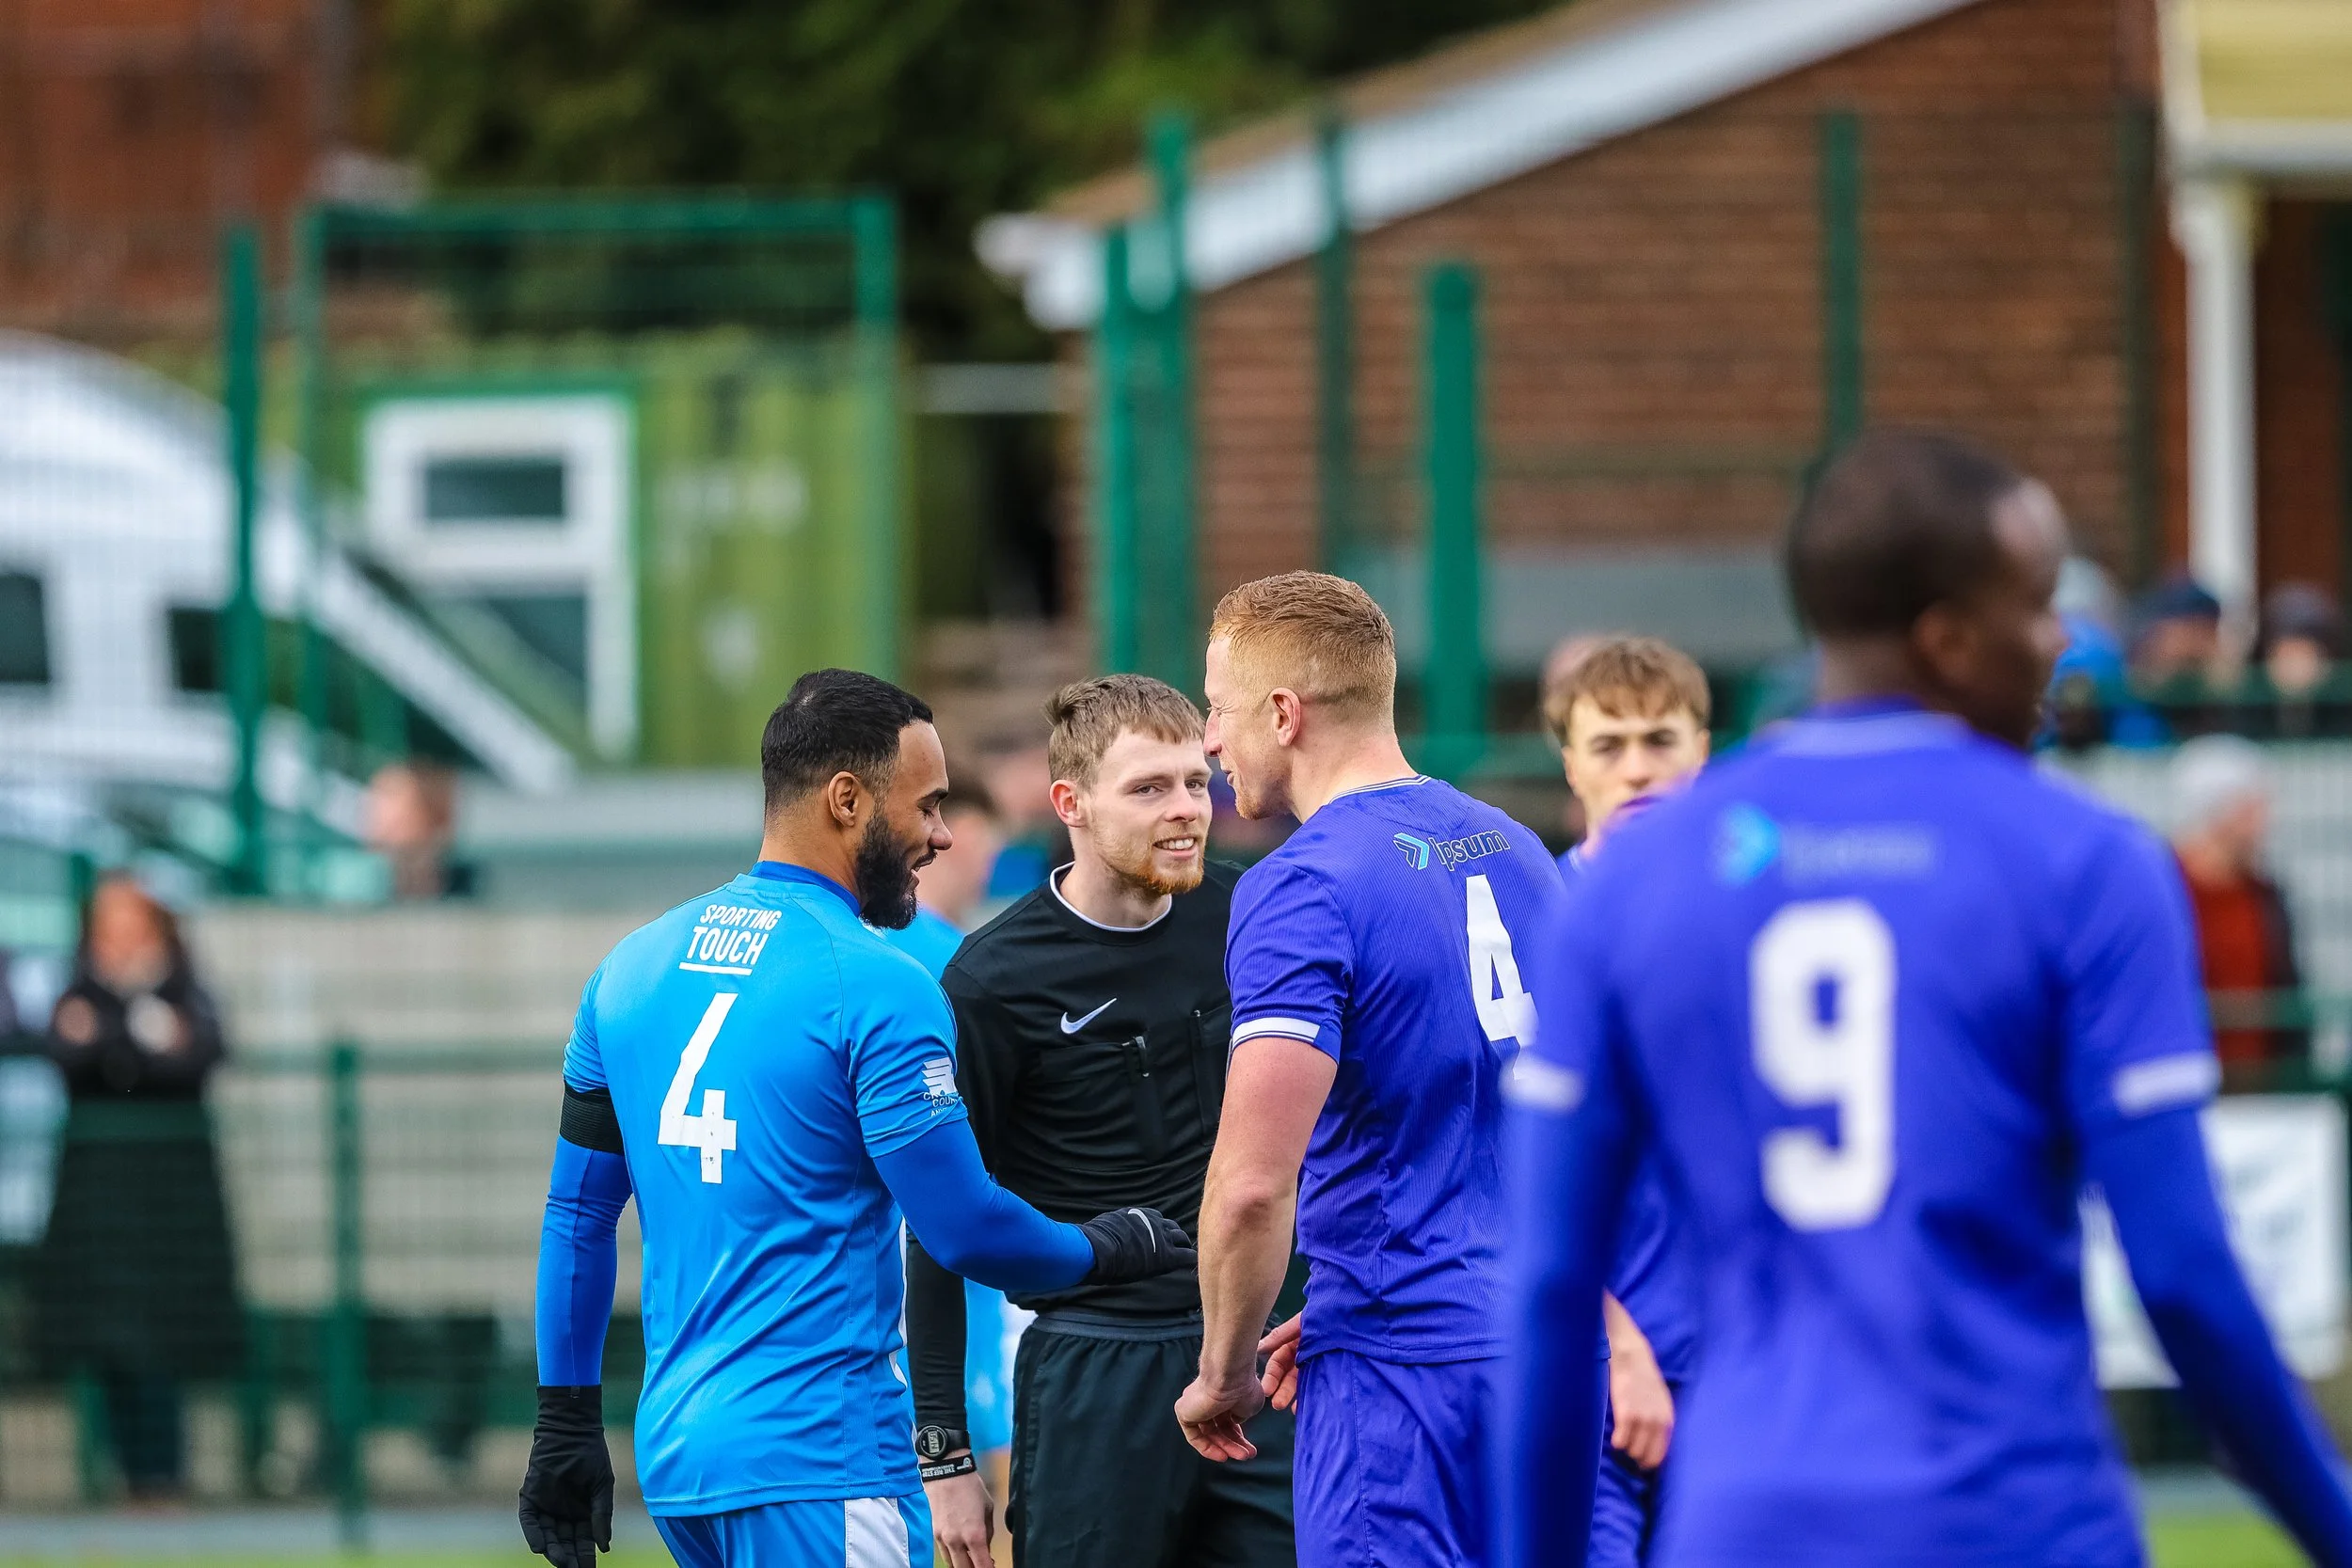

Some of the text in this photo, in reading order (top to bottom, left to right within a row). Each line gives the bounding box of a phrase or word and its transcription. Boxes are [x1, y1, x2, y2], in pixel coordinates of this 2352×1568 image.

[1427, 830, 1511, 871] Ipsum
[686, 926, 770, 965] TOUCH
[700, 904, 783, 930] SPORTING
[1466, 874, 1539, 1079] 4
[657, 992, 739, 1184] 4
[1750, 897, 1897, 1232] 9
